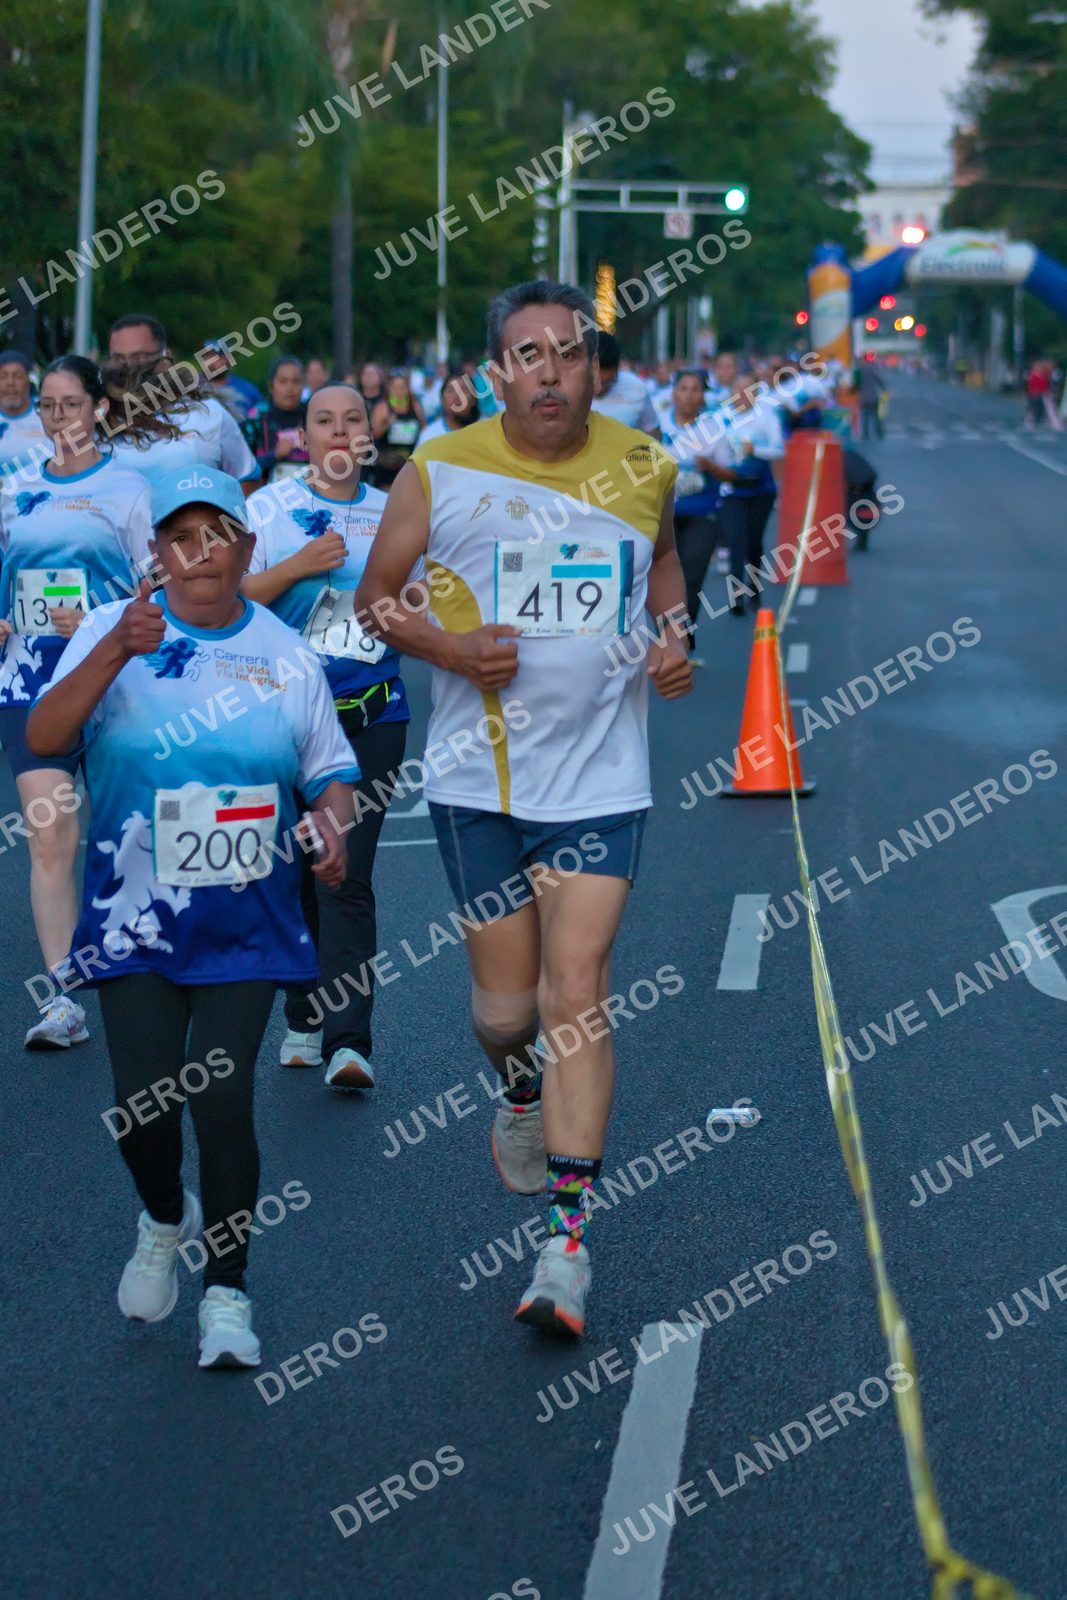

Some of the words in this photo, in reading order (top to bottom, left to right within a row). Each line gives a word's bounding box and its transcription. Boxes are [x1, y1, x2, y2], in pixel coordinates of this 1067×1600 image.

[177, 472, 213, 490] alo
[17, 598, 82, 627] 13
[516, 581, 602, 622] 419
[214, 648, 269, 665] Carrera
[215, 660, 231, 670] por
[246, 665, 271, 676] Vida
[235, 671, 288, 693] Integridad
[176, 828, 261, 871] 200
